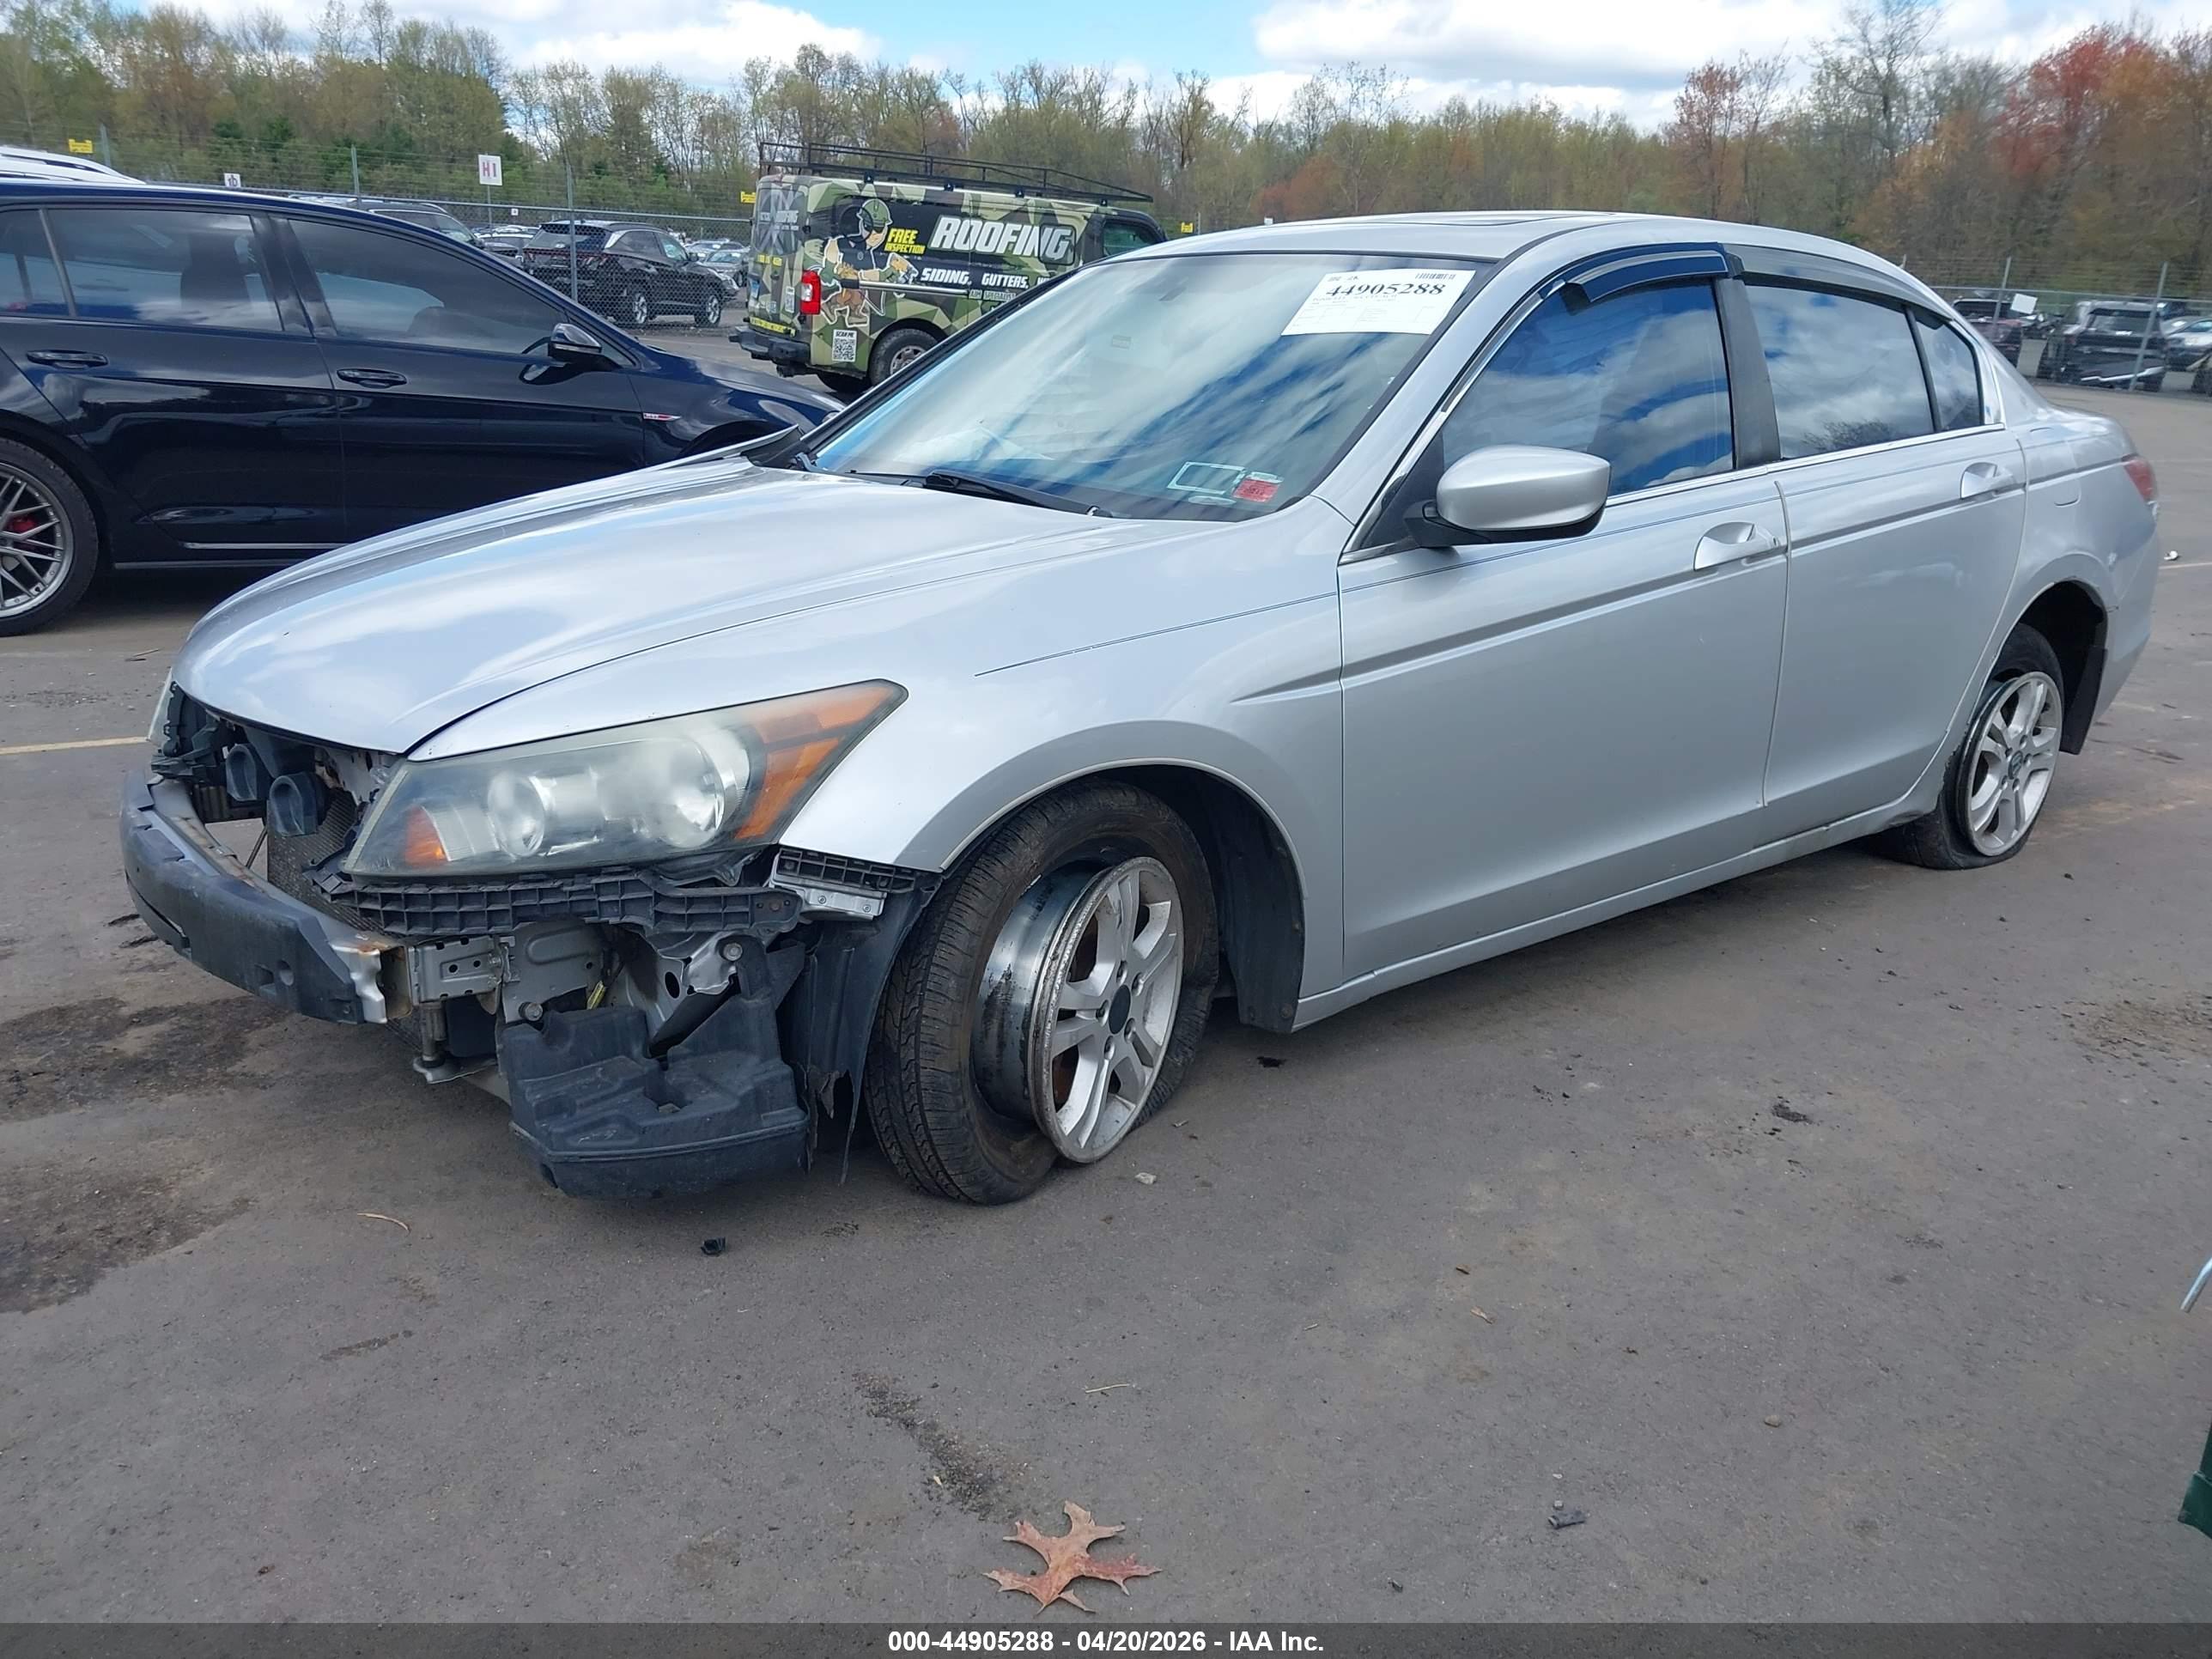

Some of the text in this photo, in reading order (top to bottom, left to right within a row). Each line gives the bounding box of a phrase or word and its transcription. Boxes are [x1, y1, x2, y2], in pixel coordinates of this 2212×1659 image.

[888, 228, 919, 245] FREE
[930, 216, 1072, 258] ROOFING
[884, 243, 926, 255] INSPECTION
[1326, 283, 1446, 296] 44905288
